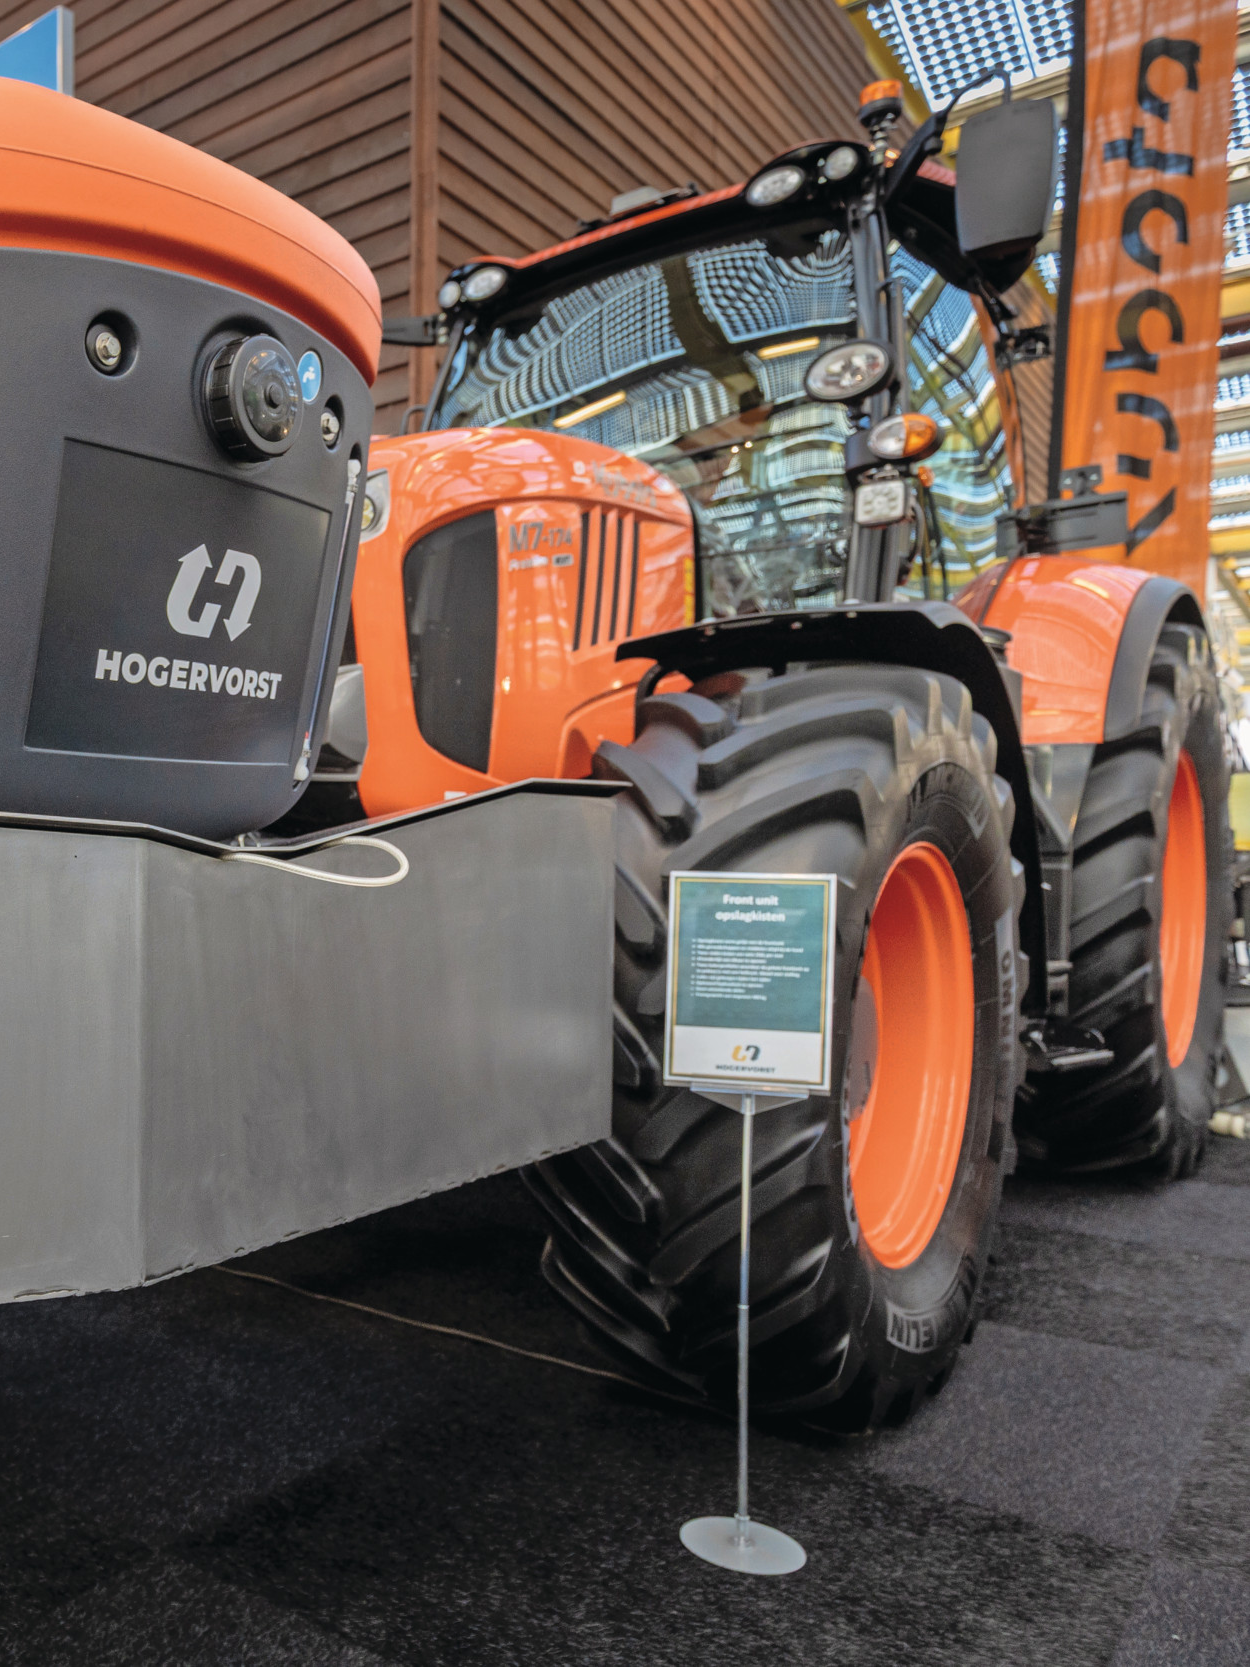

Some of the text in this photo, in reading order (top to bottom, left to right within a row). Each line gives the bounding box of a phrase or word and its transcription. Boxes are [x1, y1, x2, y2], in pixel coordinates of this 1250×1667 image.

[95, 648, 282, 700] HOGERVORST
[723, 894, 779, 906] Front unit
[715, 910, 786, 923] opslagkisten
